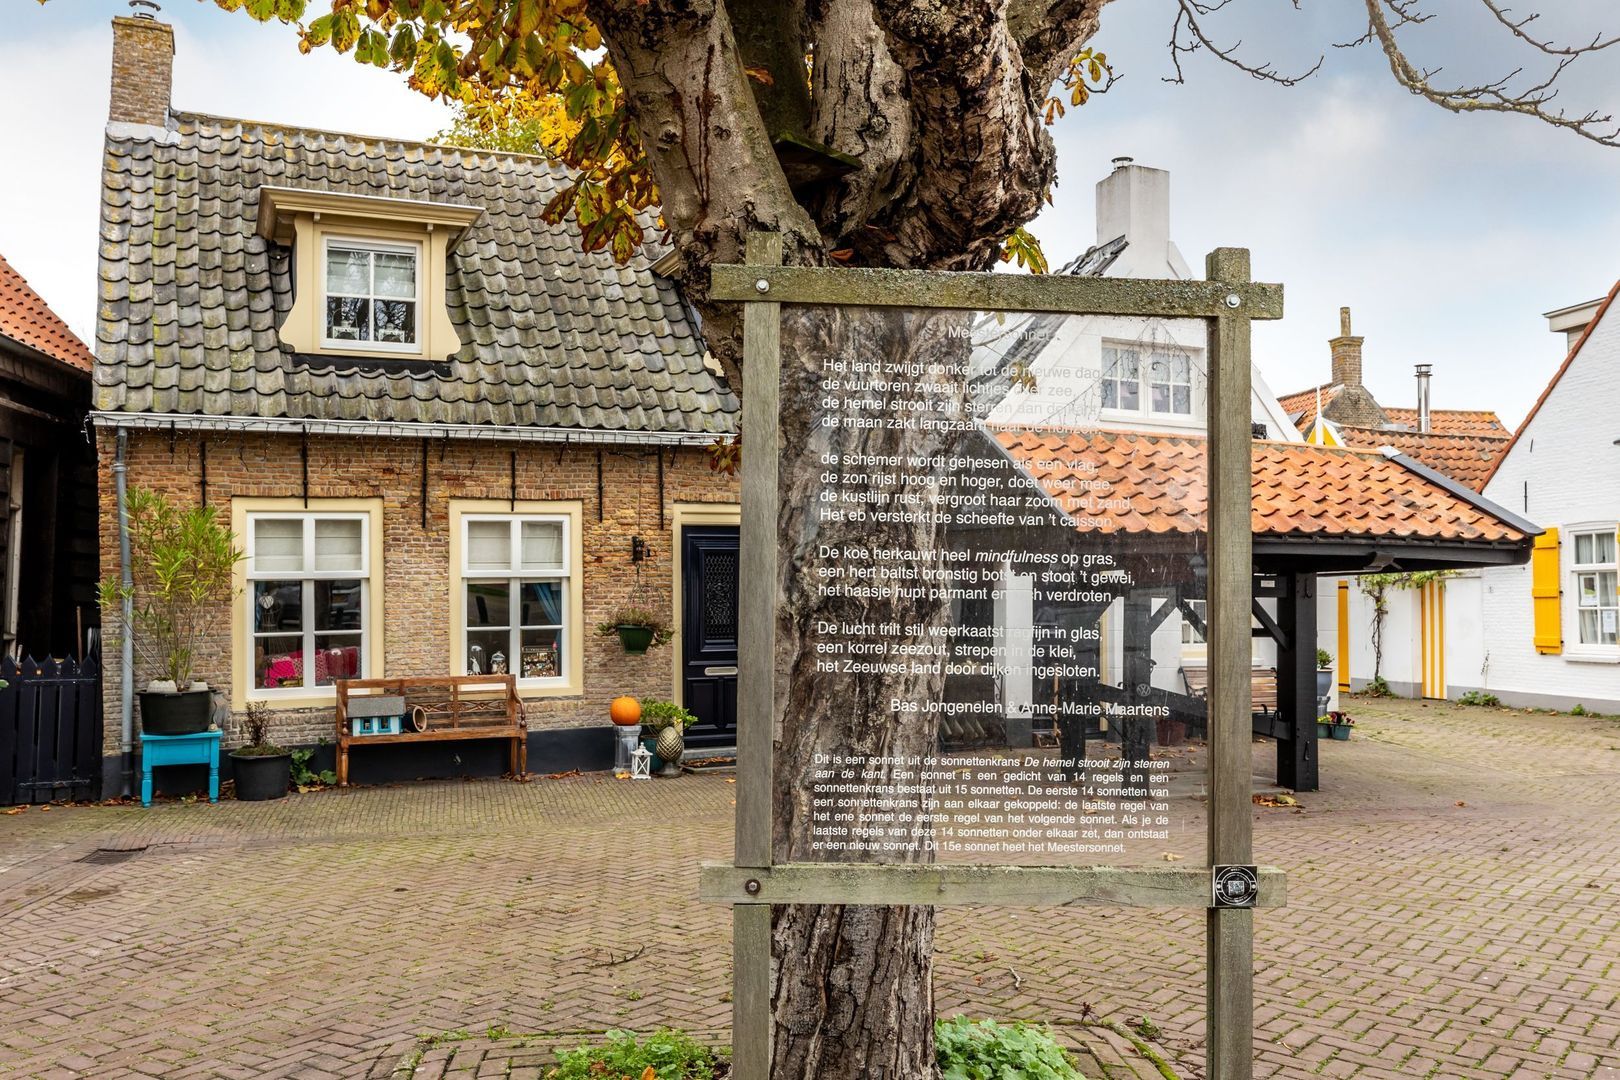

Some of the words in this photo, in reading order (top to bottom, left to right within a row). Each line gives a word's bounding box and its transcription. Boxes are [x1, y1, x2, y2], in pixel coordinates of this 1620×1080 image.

[823, 360, 848, 372] Het
[852, 360, 880, 373] land
[885, 361, 924, 377] zwijgt
[928, 362, 976, 375] donker
[1074, 365, 1100, 381] dag
[822, 378, 840, 390] de
[844, 378, 910, 392] vuurtoren
[914, 380, 958, 393] zwaait
[962, 381, 1009, 397] lichtjes
[822, 397, 839, 409] de
[844, 397, 887, 410] hemel
[890, 398, 933, 411] strooit
[936, 399, 960, 415] zijn
[821, 416, 839, 428] de
[844, 419, 882, 429] maan
[887, 417, 916, 430] zakt
[920, 418, 986, 434] langzaam
[820, 453, 839, 465] de
[842, 453, 903, 467] schemer
[906, 455, 946, 468] wordt
[949, 456, 1008, 472] gehesen
[1013, 457, 1032, 470] als
[1067, 458, 1099, 474] vlag,
[820, 471, 838, 484] de
[842, 475, 867, 484] zon
[872, 472, 896, 488] rijst
[900, 473, 935, 489] hoog
[939, 477, 957, 486] en
[961, 474, 1004, 490] hoger,
[1008, 475, 1039, 488] doet
[1042, 479, 1076, 489] weer
[1080, 480, 1114, 491] mee,
[820, 490, 838, 503] de
[842, 490, 890, 506] kustlijn
[894, 492, 924, 506] rust,
[929, 492, 986, 508] vergroot
[990, 494, 1021, 507] haar
[1024, 497, 1063, 508] zoom
[1097, 496, 1134, 509] zand.
[820, 509, 844, 521] Het
[848, 509, 866, 522] eb
[870, 510, 930, 523] versterkt
[934, 511, 952, 524] de
[956, 511, 1015, 525] scheefte
[1019, 516, 1044, 526] van
[1060, 514, 1116, 527] caisson.
[819, 546, 839, 559] De
[843, 547, 868, 560] koe
[873, 547, 937, 561] herkauwt
[941, 549, 971, 562] heel
[975, 549, 1059, 563] mindfulness
[1061, 554, 1078, 567] op
[1082, 554, 1117, 567] gras,
[818, 568, 845, 578] een
[849, 566, 877, 578] hert
[880, 566, 918, 579] baltst
[922, 567, 978, 583] bronstig
[1041, 569, 1076, 582] stoot
[1090, 571, 1136, 586] gewei,
[818, 584, 840, 597] het
[844, 584, 891, 600] haasje
[895, 586, 926, 601] hupt
[930, 586, 987, 602] parmant
[817, 622, 839, 635] De
[842, 623, 875, 636] lucht
[879, 624, 901, 636] trilt
[904, 624, 924, 636] stil
[928, 624, 1004, 638] weerkaatst
[1054, 627, 1066, 639] in
[1070, 627, 1103, 642] glas,
[816, 644, 843, 654] een
[847, 642, 887, 655] korrel
[891, 643, 951, 657] zeezout,
[954, 644, 1006, 659] strepen
[1027, 645, 1045, 657] de
[1049, 645, 1076, 659] klei,
[816, 660, 839, 673] het
[843, 661, 907, 674] Zeeuwse
[911, 662, 941, 675] land
[945, 662, 977, 675] door
[890, 700, 918, 713] Bas
[921, 701, 1002, 717] Jongenelen
[1006, 702, 1019, 714] &
[1020, 702, 1101, 716] Anne-Marie
[1105, 703, 1170, 717] Maartens
[814, 754, 830, 764] Dit
[833, 754, 841, 764] is
[845, 756, 865, 765] een
[869, 755, 904, 765] sonnet
[908, 755, 921, 765] uit
[924, 755, 937, 766] de
[940, 756, 1020, 767] sonnettenkrans
[1024, 757, 1039, 767] De
[1042, 757, 1075, 767] hemel
[1077, 757, 1110, 768] strooit
[1133, 758, 1170, 769] sterren
[815, 770, 835, 779] aan
[841, 769, 855, 779] de
[893, 769, 914, 780] Een
[977, 772, 997, 781] een
[1003, 771, 1041, 783] gedicht
[1047, 773, 1067, 782] van
[1073, 772, 1086, 782] 14
[1092, 772, 1124, 785] regels
[1149, 775, 1169, 783] een
[813, 782, 894, 794] sonnettenkrans
[955, 784, 967, 795] 15
[970, 784, 1025, 795] sonnetten.
[1027, 785, 1043, 795] De
[1045, 785, 1078, 796] eerste
[1081, 786, 1094, 796] 14
[1096, 786, 1147, 797] sonnetten
[1150, 789, 1169, 797] van
[813, 799, 834, 807] een
[944, 800, 964, 809] aan
[967, 799, 1000, 809] elkaar
[1004, 799, 1061, 812] gekoppeld:
[1064, 800, 1078, 810] de
[1082, 800, 1116, 810] laatste
[1150, 803, 1169, 811] van
[813, 811, 830, 821] het
[834, 813, 854, 822] ene
[858, 811, 895, 822] sonnet
[953, 812, 980, 825] regel
[984, 815, 1003, 823] van
[1007, 813, 1024, 823] het
[1080, 813, 1118, 824] sonnet.
[1121, 814, 1138, 824] Als
[1142, 814, 1152, 826] je
[1155, 814, 1169, 824] de
[813, 826, 848, 836] laatste
[851, 826, 884, 839] regels
[887, 829, 907, 837] van
[941, 827, 954, 837] 14
[1012, 828, 1042, 838] onder
[1046, 828, 1077, 838] elkaar
[1104, 828, 1124, 839] dan
[1127, 828, 1169, 839] ontstaat
[883, 840, 921, 851] sonnet.
[943, 841, 961, 851] 15e
[964, 841, 999, 852] sonnet
[1047, 842, 1126, 853] Meestersonnet.
